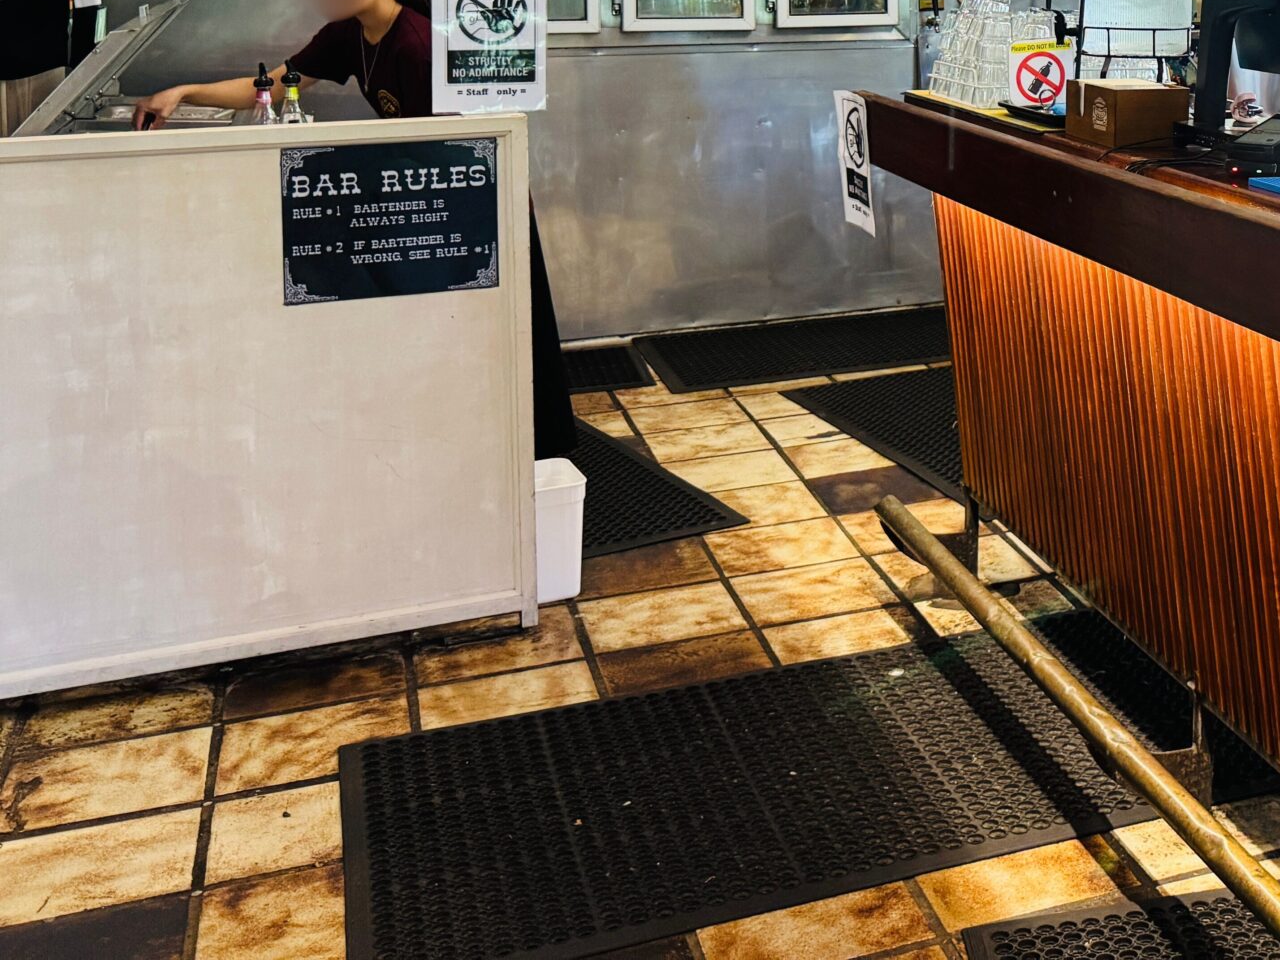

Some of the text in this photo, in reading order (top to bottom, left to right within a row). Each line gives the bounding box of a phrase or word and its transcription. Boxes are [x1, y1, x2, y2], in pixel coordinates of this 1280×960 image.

[468, 56, 513, 66] STRICTLY
[452, 67, 529, 78] NO ADMITTANCE
[466, 88, 517, 97] Staff only
[291, 164, 487, 198] BAR RULES
[292, 207, 322, 220] RULE
[353, 200, 427, 214] BARTENDER
[432, 199, 446, 209] IS
[350, 212, 449, 228] ALWAYS RIGHT
[292, 244, 322, 256] RULE
[353, 240, 366, 251] IF
[371, 234, 444, 250] BARTENDER
[450, 233, 462, 243] IS
[408, 250, 431, 261] SEE
[436, 246, 468, 258] RULE
